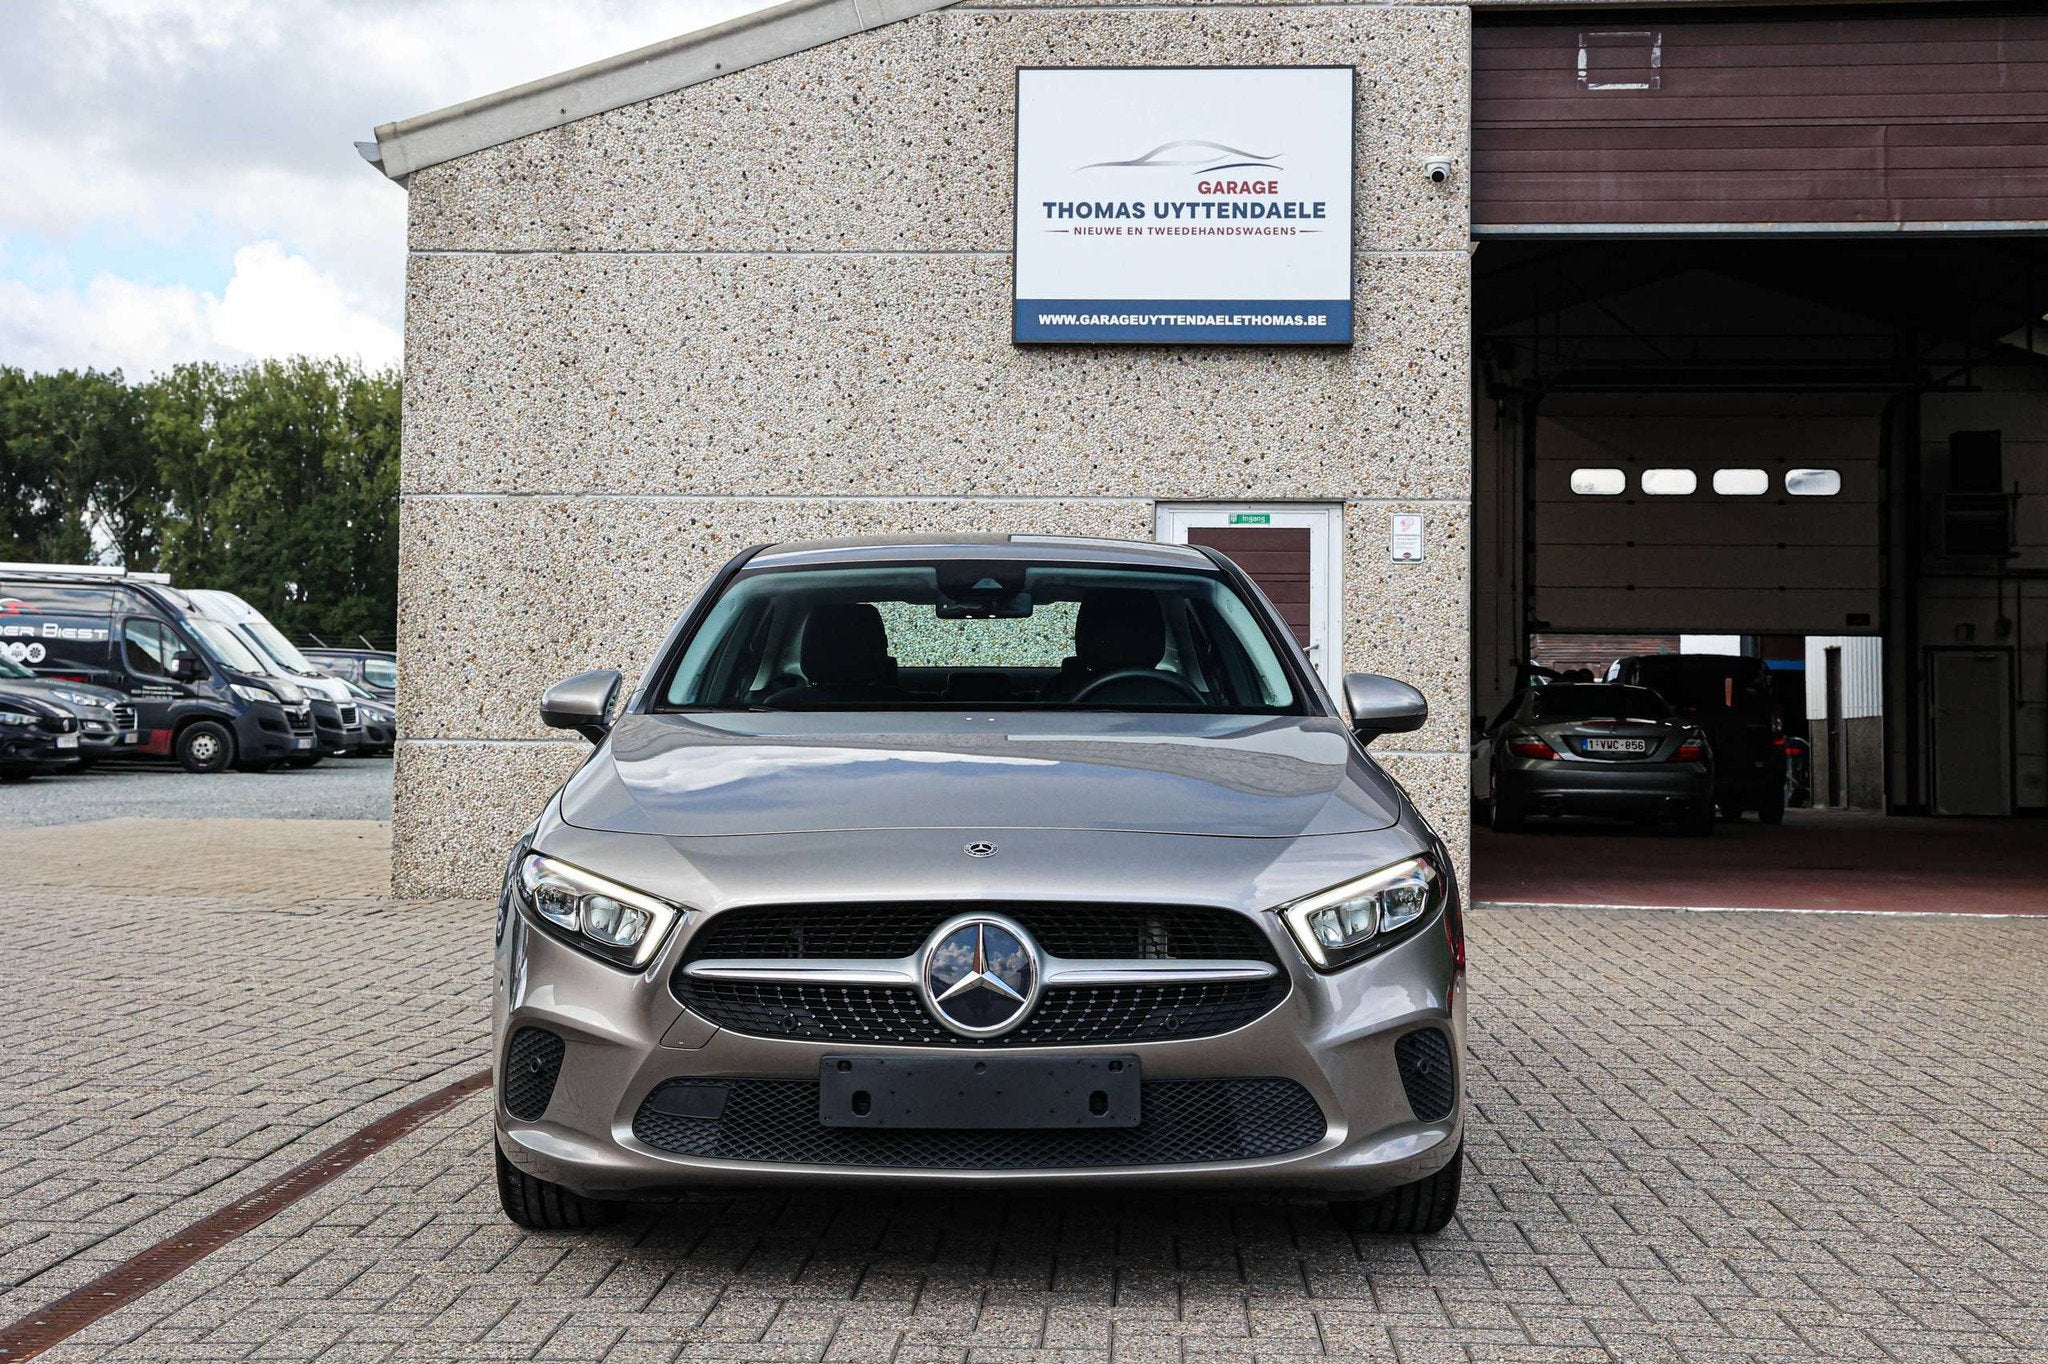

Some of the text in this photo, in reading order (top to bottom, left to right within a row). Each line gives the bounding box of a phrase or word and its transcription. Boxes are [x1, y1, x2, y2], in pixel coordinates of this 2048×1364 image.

[1197, 180, 1279, 195] GARAGE
[1042, 201, 1326, 219] THOMAS UYTTENDAELE
[1073, 226, 1297, 236] NIEUWE EN TWEEDEHANDSWAGENS
[1038, 314, 1327, 326] WWW.GARAGEUYTTENDAELETHOMAS.BE
[1242, 514, 1266, 523] Ingang
